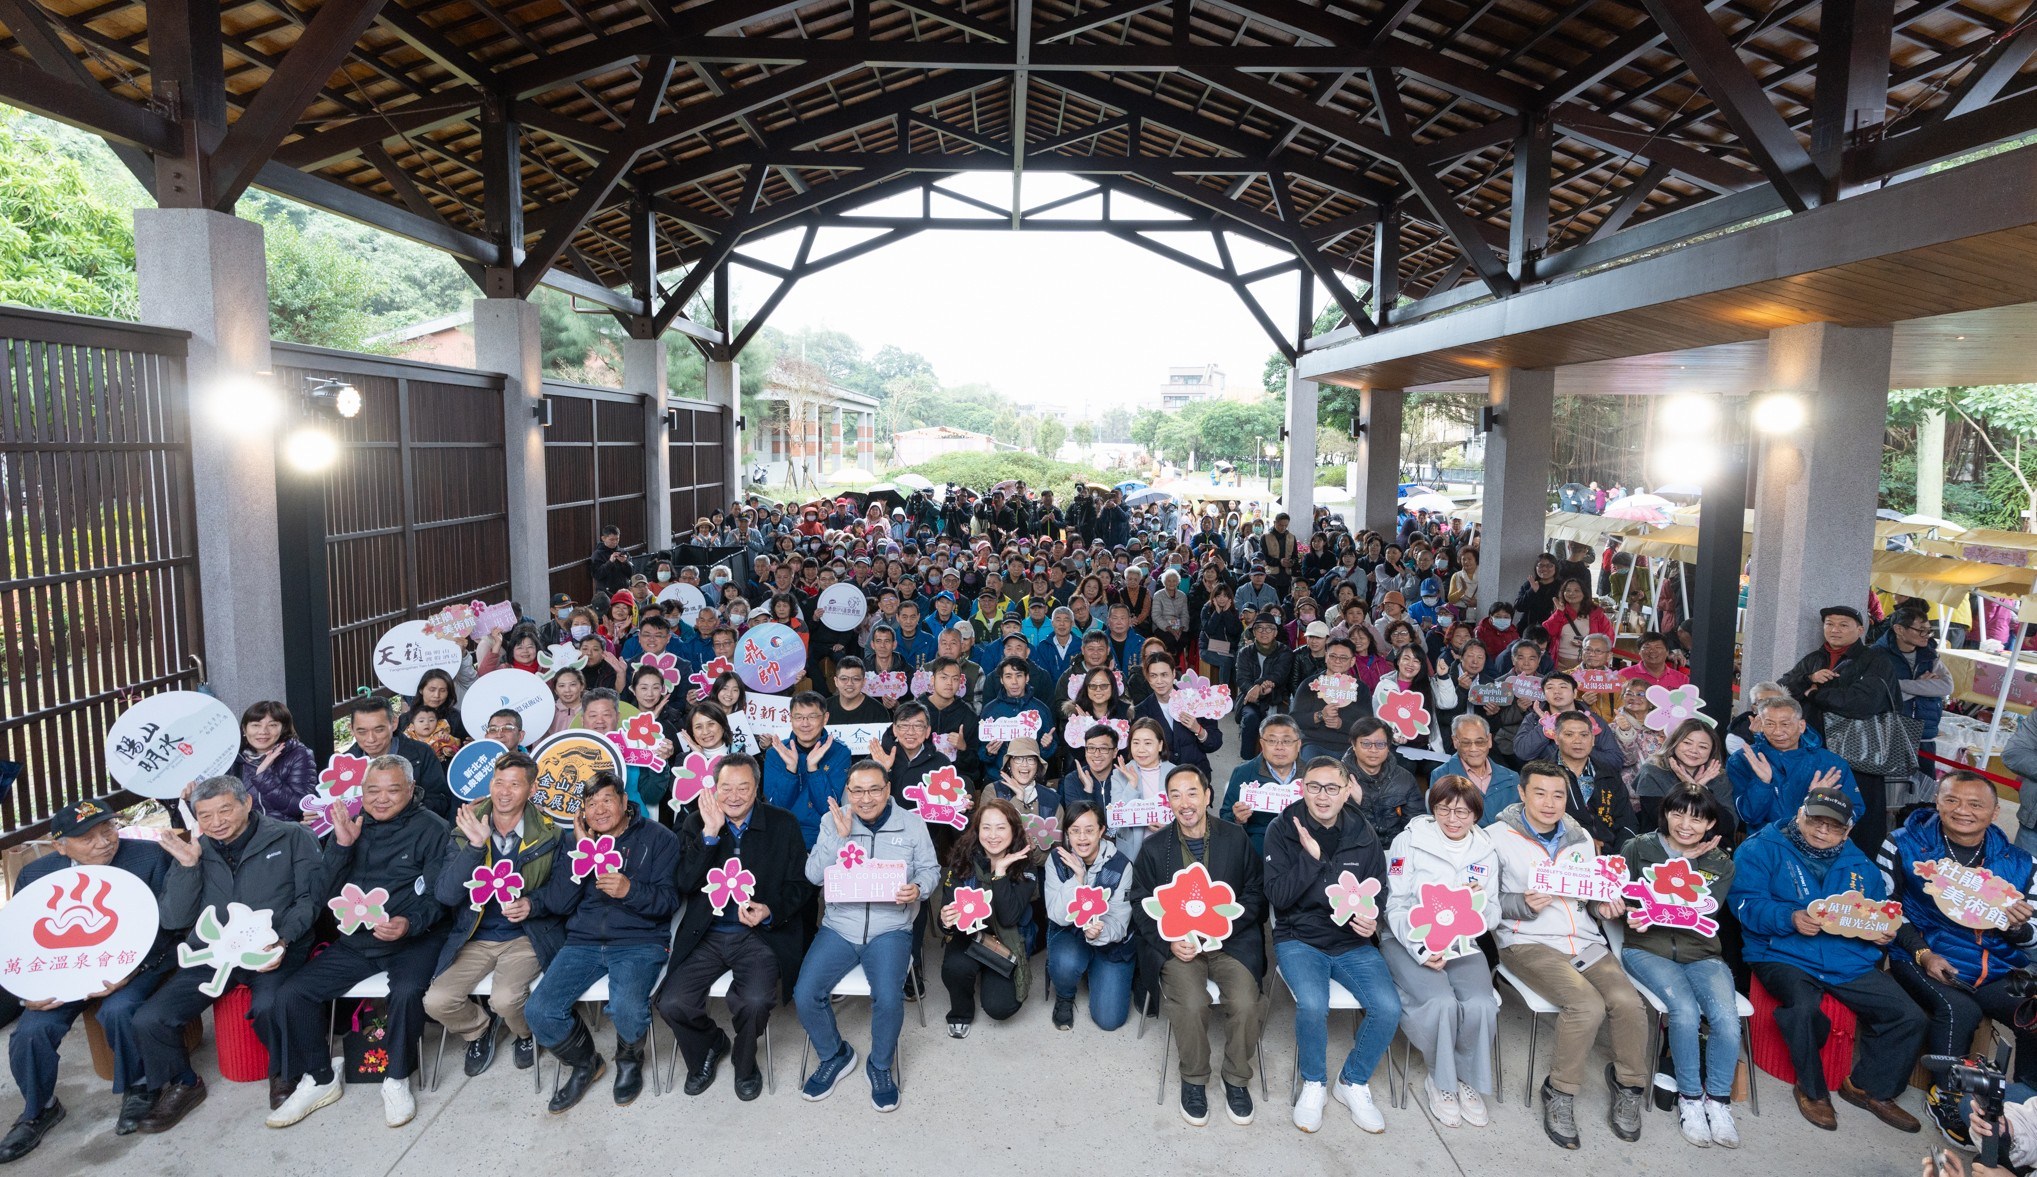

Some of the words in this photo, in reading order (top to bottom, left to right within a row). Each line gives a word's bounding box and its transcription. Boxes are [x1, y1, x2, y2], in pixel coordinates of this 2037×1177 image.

[463, 754, 488, 779] 新北市
[891, 837, 903, 846] UR
[828, 872, 852, 880] LET'S
[855, 872, 869, 880] GO
[871, 872, 905, 881] BLOOM
[1469, 864, 1486, 874] KMT
[1938, 860, 1985, 892] 杜鵑
[1533, 873, 1615, 901] 馬上出花
[1828, 902, 1852, 915] 萬里
[1941, 886, 2009, 929] 美術館
[1839, 915, 1889, 932] 觀光公園
